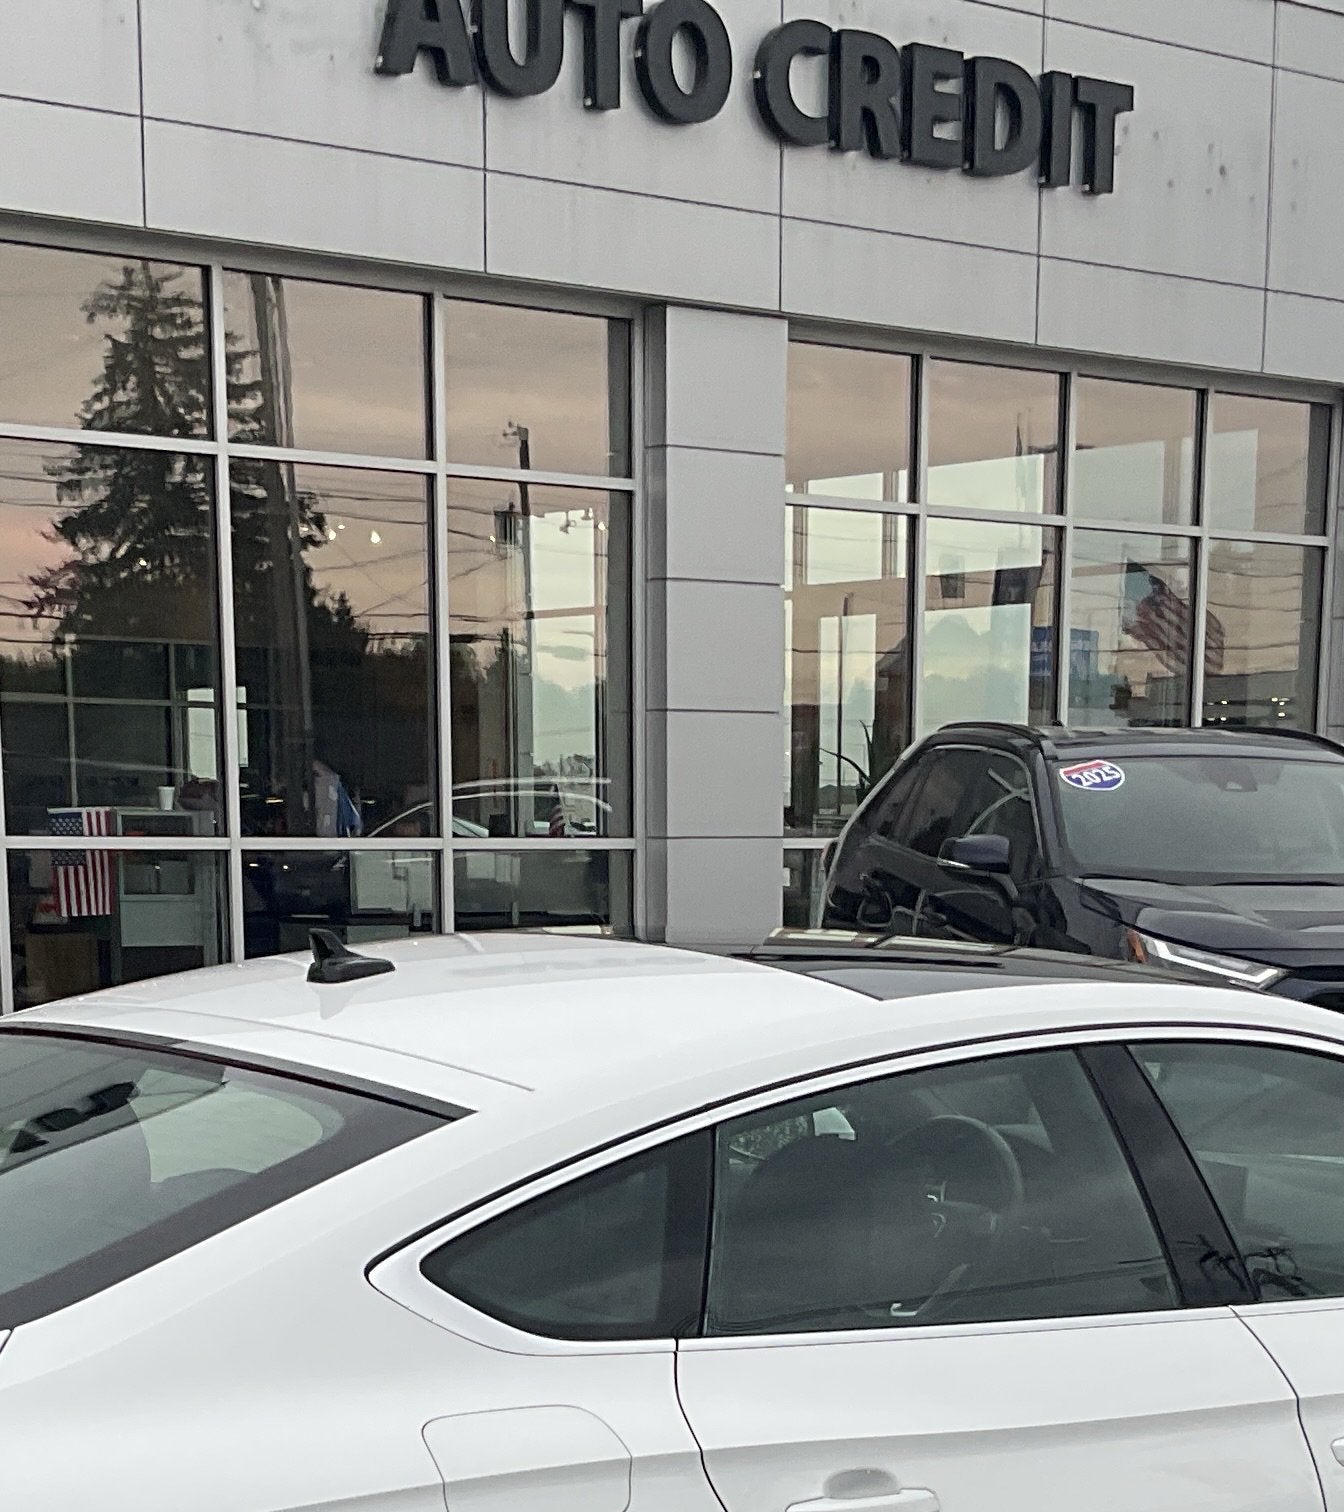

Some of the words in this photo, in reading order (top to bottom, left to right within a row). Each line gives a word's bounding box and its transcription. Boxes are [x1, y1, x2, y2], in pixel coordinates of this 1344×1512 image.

[374, 0, 732, 124] AUTO
[753, 19, 1134, 194] CREDIT
[1072, 765, 1121, 787] 2025
